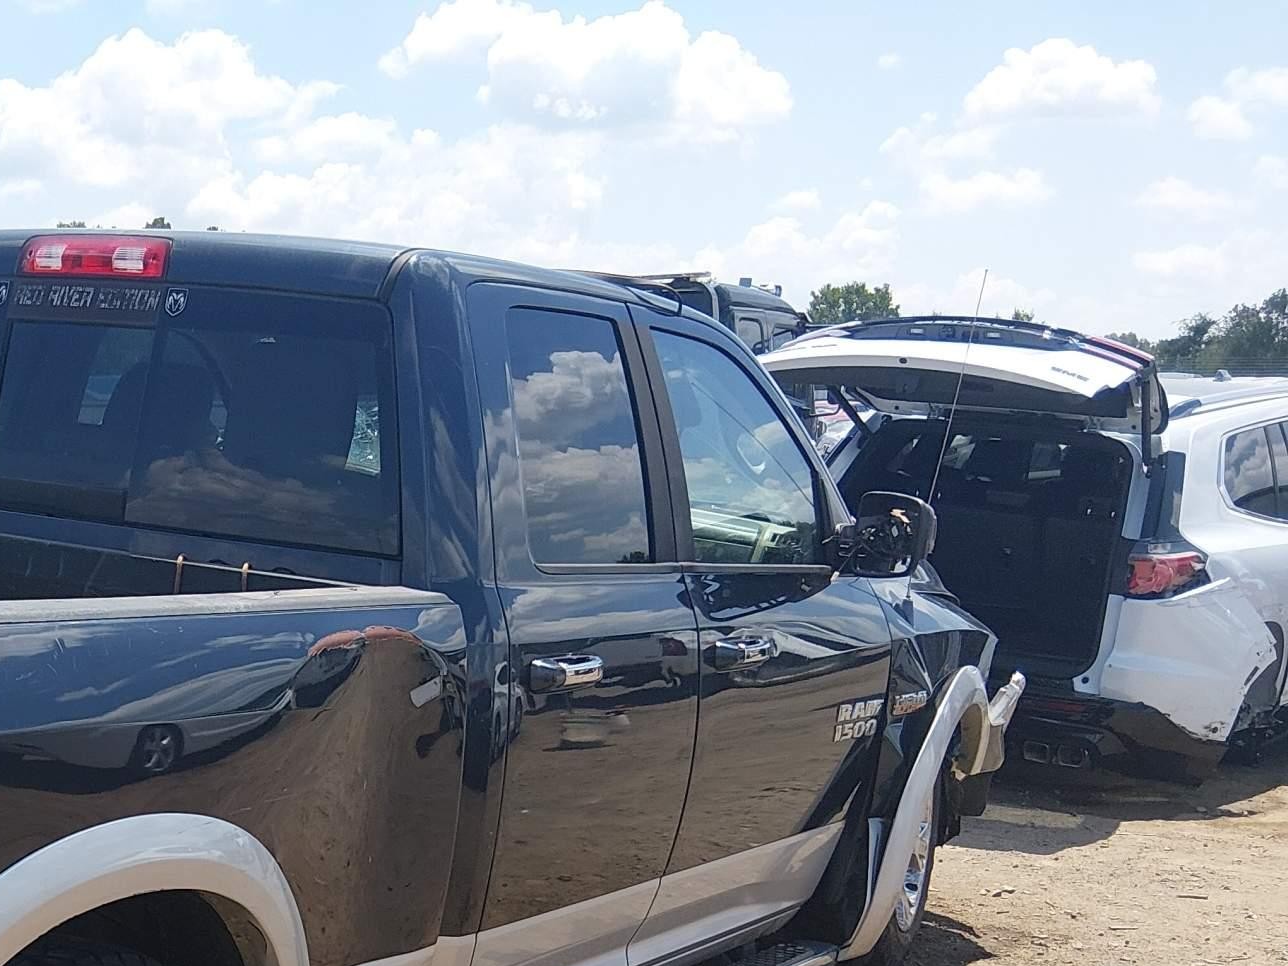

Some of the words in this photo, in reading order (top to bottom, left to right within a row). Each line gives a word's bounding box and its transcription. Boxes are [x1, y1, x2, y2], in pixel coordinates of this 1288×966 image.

[49, 285, 95, 308] RIVER
[838, 699, 884, 722] RAM
[833, 719, 877, 742] 1500
